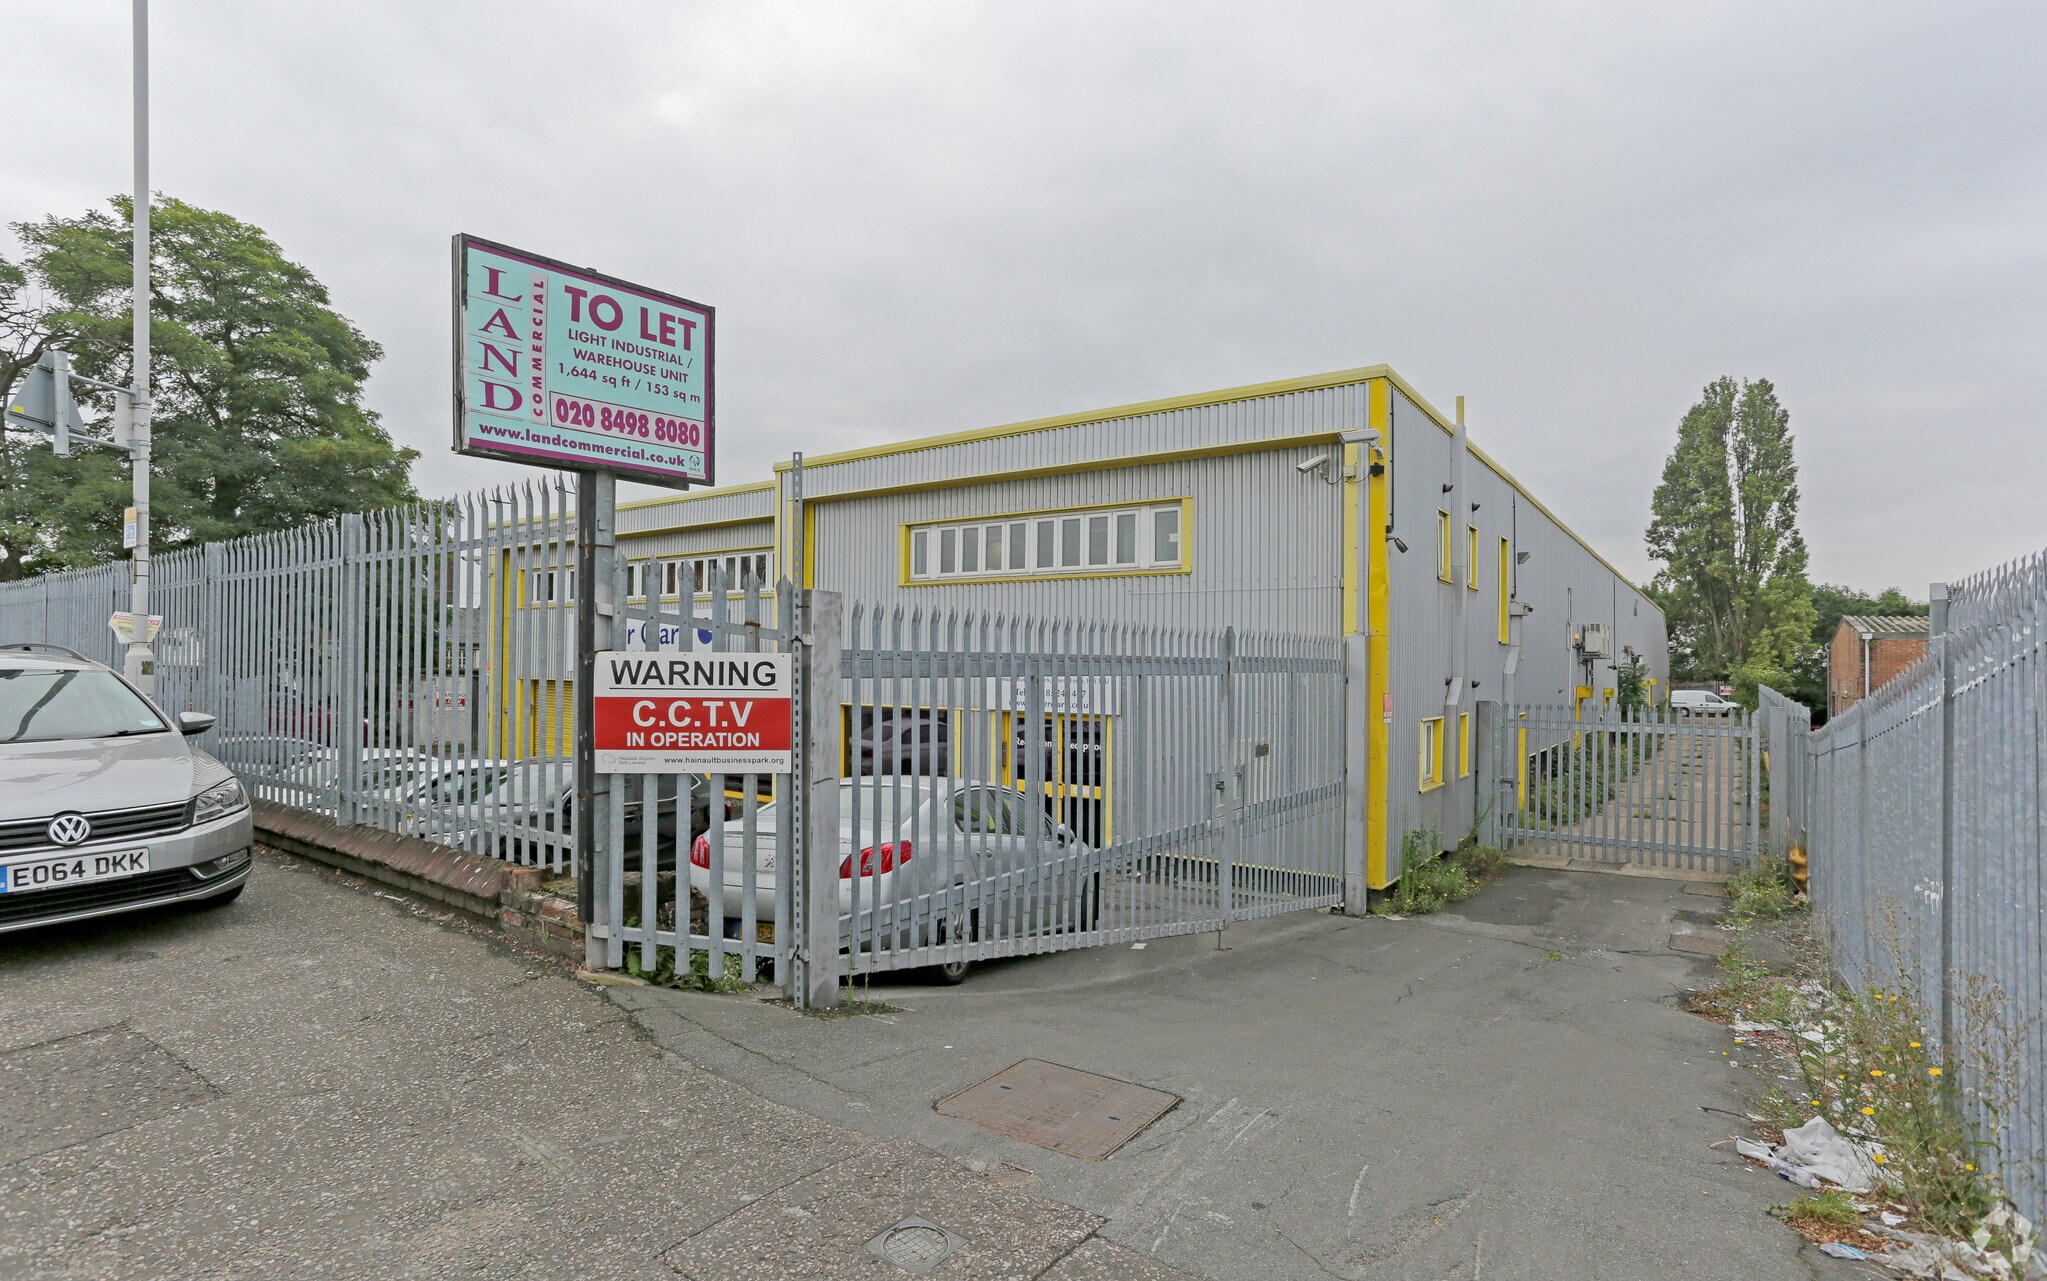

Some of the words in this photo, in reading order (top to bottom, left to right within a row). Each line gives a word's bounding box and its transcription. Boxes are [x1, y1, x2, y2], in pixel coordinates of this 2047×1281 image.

[564, 285, 624, 331] TO
[640, 306, 697, 351] LET
[532, 280, 545, 417] COMMERCIAL
[568, 328, 607, 347] LIGHT
[611, 339, 683, 366] INDUSTRIAL
[573, 347, 656, 376] WAREHOUSE
[660, 368, 689, 383] UNIT
[559, 362, 598, 381] 1,644
[602, 375, 617, 388] sq
[621, 375, 631, 387] ft
[647, 381, 669, 396] 153
[673, 390, 686, 402] sq
[690, 394, 700, 403] m
[555, 398, 595, 428] 020
[601, 407, 650, 438] 8498
[655, 417, 700, 447] 8080
[479, 423, 685, 467] www.landcommercial.co.uk
[610, 659, 776, 686] WARNING
[632, 700, 754, 728] C.C.T.V
[626, 732, 645, 747] IN
[651, 732, 760, 747] OPERATION
[664, 756, 784, 766] www.hainaultbusinesspark.org
[95, 851, 145, 876] DKK
